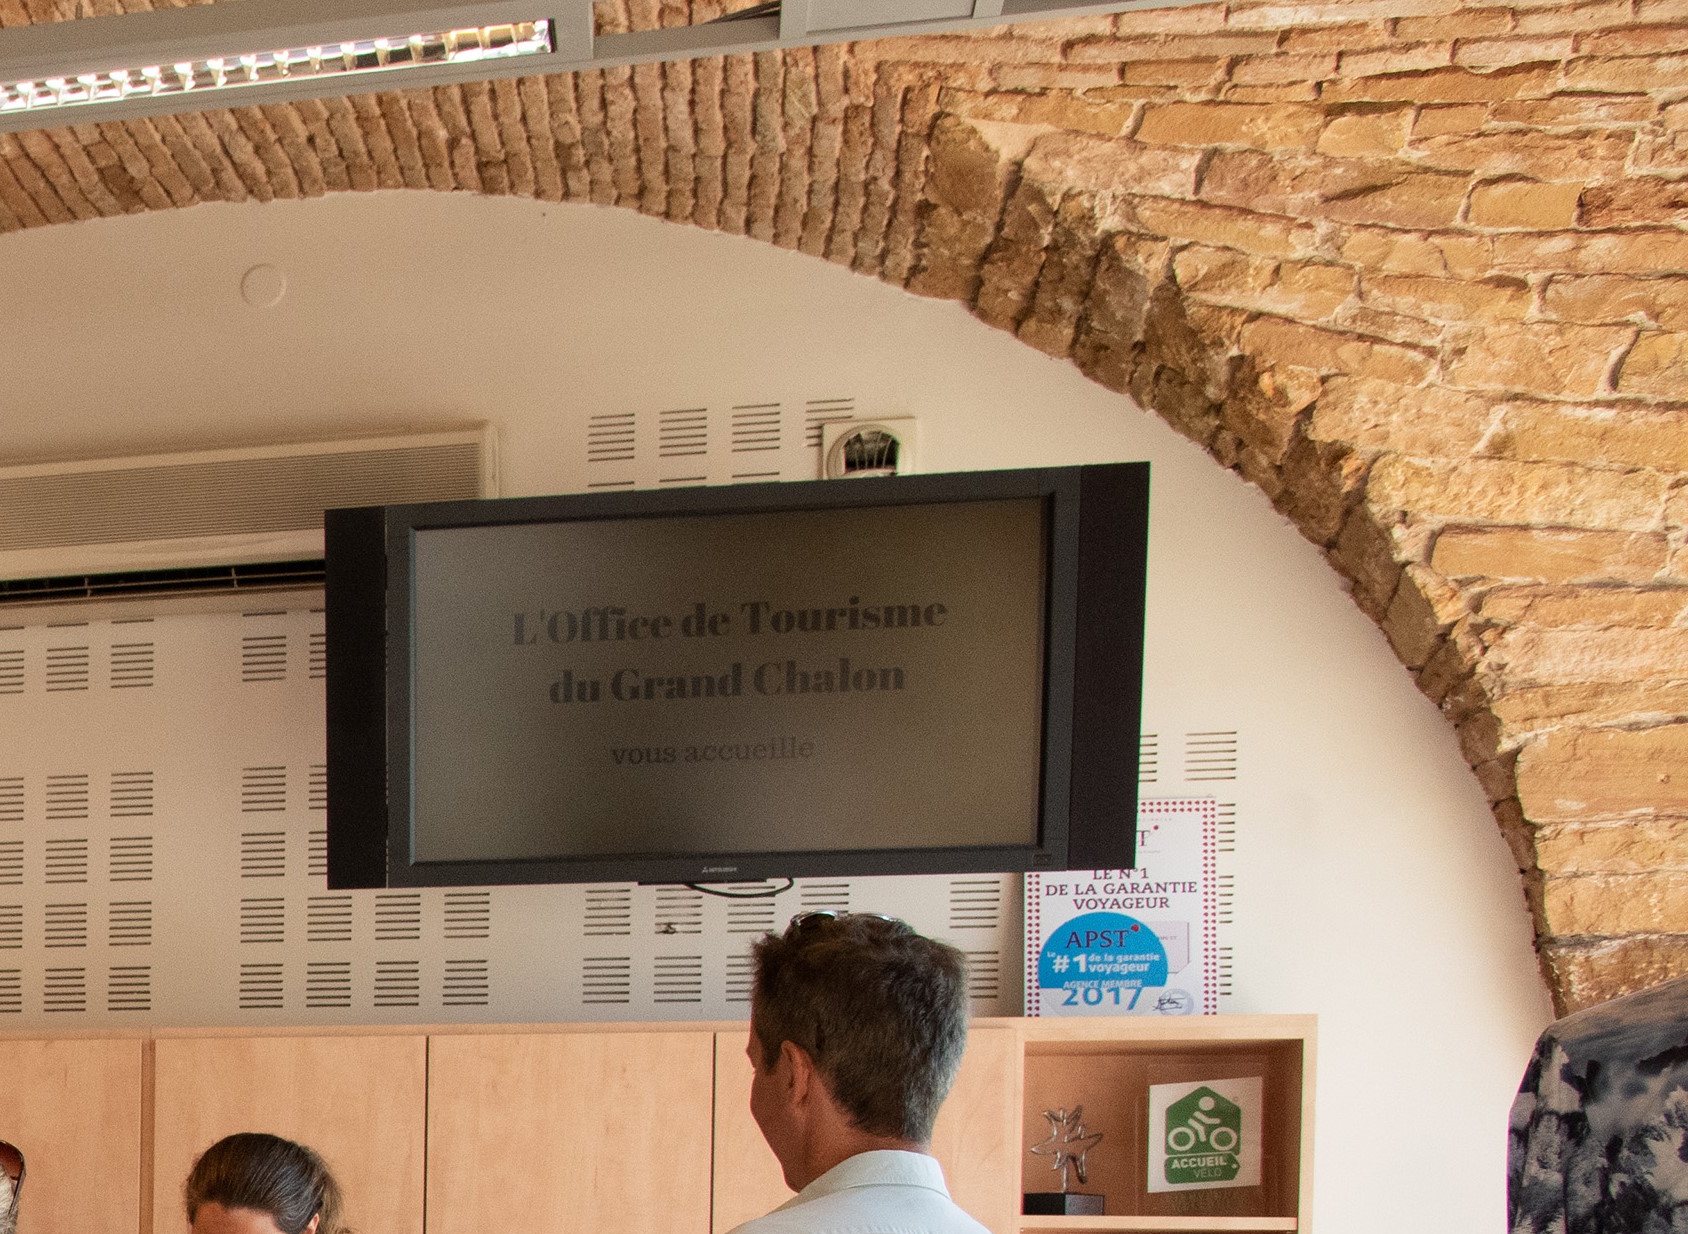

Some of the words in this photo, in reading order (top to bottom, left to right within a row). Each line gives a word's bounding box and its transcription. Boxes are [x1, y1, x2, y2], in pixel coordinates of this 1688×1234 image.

[513, 606, 673, 646] L'Office
[681, 602, 731, 639] de
[741, 596, 948, 635] Tourisme
[549, 669, 601, 704] du
[612, 663, 742, 702] Grand
[753, 657, 906, 696] Chalon
[612, 743, 678, 765] vous
[684, 736, 813, 764] accueille
[1092, 868, 1112, 881] LE
[1045, 884, 1069, 896] DE
[1075, 883, 1098, 896] LA
[1103, 881, 1198, 895] GARANTIE
[1072, 897, 1170, 910] VOYAGEUR
[1066, 930, 1130, 948] APST
[1088, 953, 1100, 962] de
[1104, 953, 1113, 962] la
[1116, 953, 1160, 963] garantie
[1088, 962, 1150, 975] voyageur
[1062, 980, 1099, 989] AGENCE
[1101, 979, 1143, 988] MEMBRE
[1061, 987, 1144, 1010] 2017
[1171, 1155, 1228, 1169] ACCUEIL
